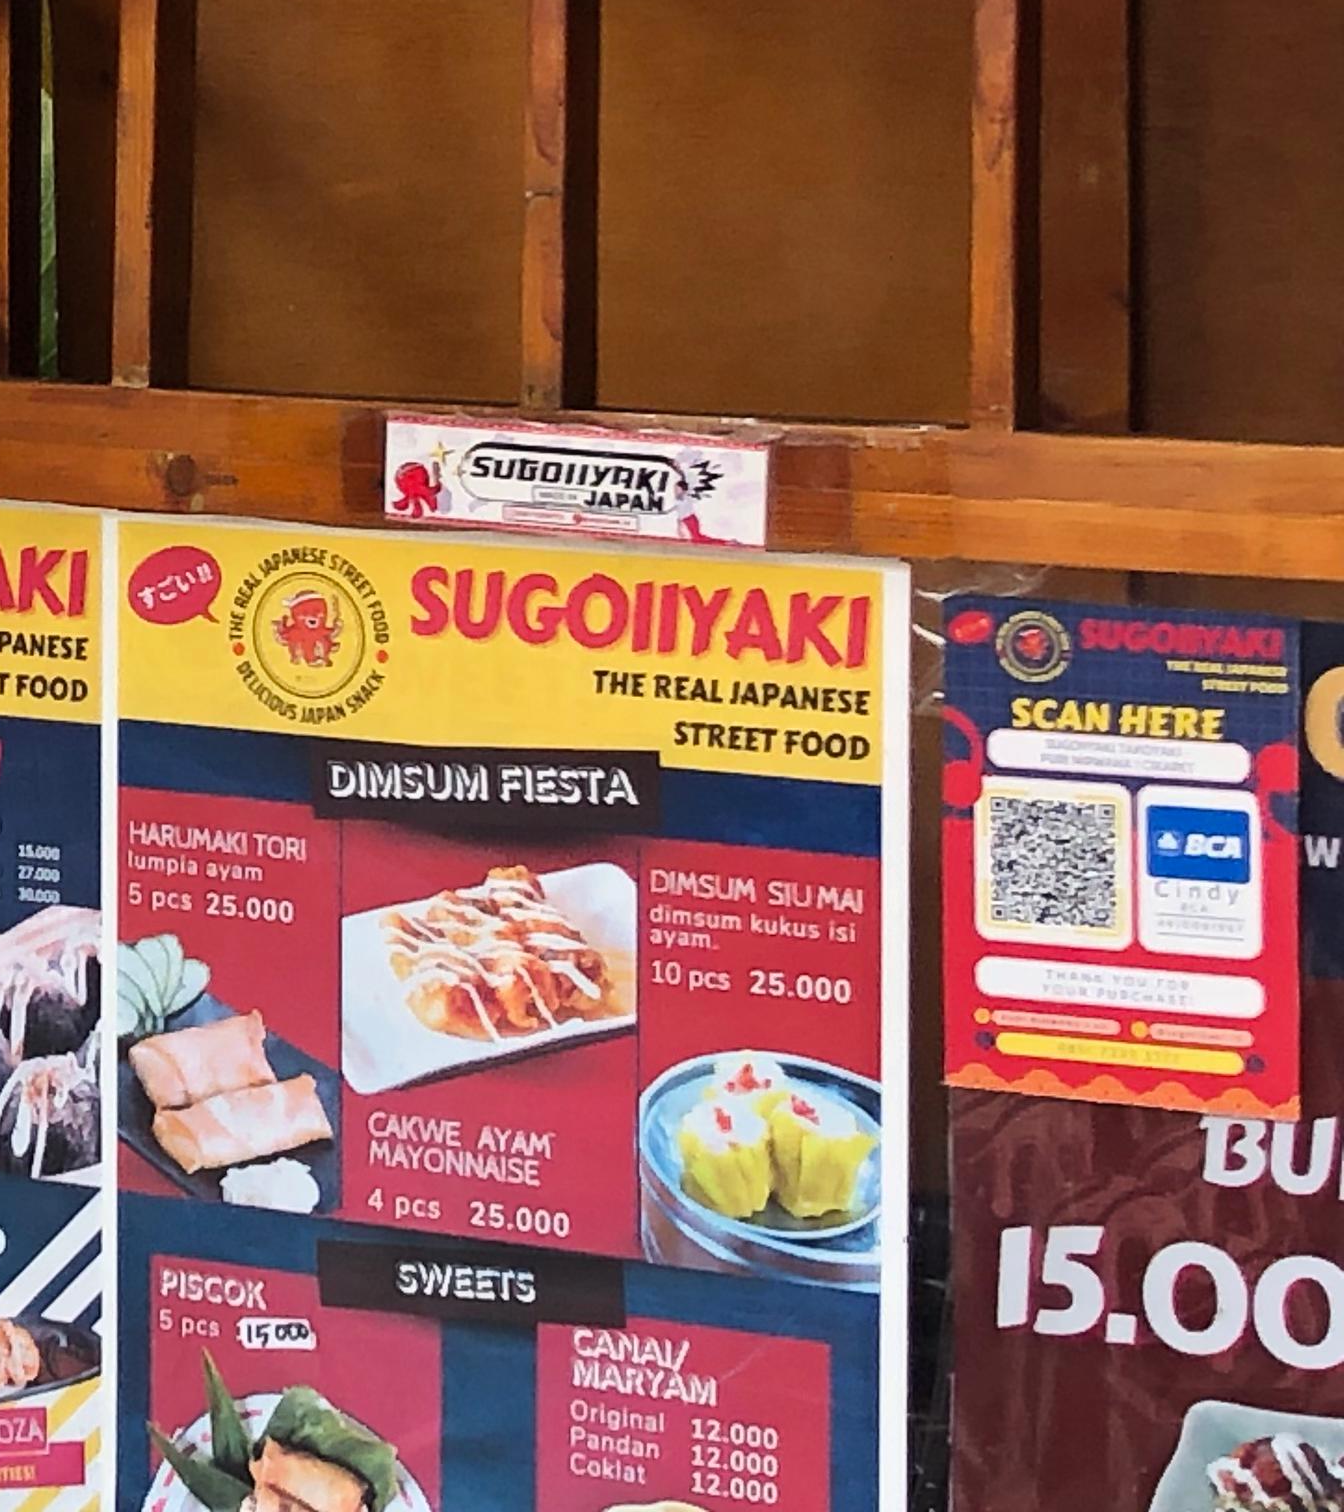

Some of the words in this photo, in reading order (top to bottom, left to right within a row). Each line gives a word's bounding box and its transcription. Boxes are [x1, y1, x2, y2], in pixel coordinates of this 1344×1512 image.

[584, 490, 664, 513] JAPAN
[257, 546, 328, 580] JAPANESE
[328, 553, 377, 599] STREET
[233, 571, 263, 611] REAL
[229, 612, 247, 641] THE
[367, 599, 390, 645] FOOD
[410, 565, 871, 669] SUGOIIYAKI
[15, 674, 89, 702] FOOD
[235, 660, 298, 721] DELICIOUS
[300, 703, 347, 725] JAPAN
[345, 668, 386, 714] SNACK
[593, 670, 646, 698] THE
[653, 673, 725, 705] REAL
[728, 680, 871, 716] JAPANESE
[674, 721, 779, 755] STREET
[783, 728, 871, 761] FOOD
[1011, 697, 1111, 734] SCAN
[1119, 703, 1226, 741] HERE
[326, 760, 490, 803] DIMSUM
[499, 765, 640, 806] FIESTA
[128, 820, 248, 857] HARUMAKI
[252, 832, 307, 863] TORI
[1184, 833, 1242, 859] BCA
[1304, 834, 1340, 868] W
[18, 865, 60, 883] 27.000
[127, 852, 199, 879] lumpia
[204, 860, 264, 883] ayam
[128, 882, 143, 905] 5
[150, 889, 193, 913] pcs
[205, 889, 295, 925] 25.000
[649, 868, 757, 903] DIMSUM
[767, 879, 812, 907] SIU
[816, 885, 865, 914] MAI
[1154, 879, 1240, 905] Cindy
[649, 904, 743, 931] dimsum
[750, 913, 820, 940] kukus
[828, 920, 856, 943] isi
[651, 959, 681, 985] 10
[688, 969, 731, 992] pcs
[749, 969, 852, 1005] 25.000
[1113, 975, 1147, 988] YOU
[367, 1111, 462, 1148] CAKWE
[477, 1125, 552, 1160] AYAM
[368, 1140, 541, 1187] MAYONNAISE
[1200, 1116, 1344, 1201] BU
[367, 1187, 384, 1212] 4
[395, 1195, 441, 1219] pcs
[469, 1200, 570, 1238] 25.000
[160, 1267, 267, 1311] PISCOK
[397, 1261, 537, 1303] SWEETS
[159, 1308, 173, 1331] 5
[181, 1316, 221, 1338] pcs
[572, 1357, 718, 1407] MARYAM
[570, 1399, 665, 1432] Original
[690, 1418, 779, 1450] 12.000
[570, 1426, 660, 1459] Pandan
[690, 1444, 779, 1476] 12.000
[570, 1452, 646, 1485] Coklat
[690, 1472, 779, 1504] 12.000
